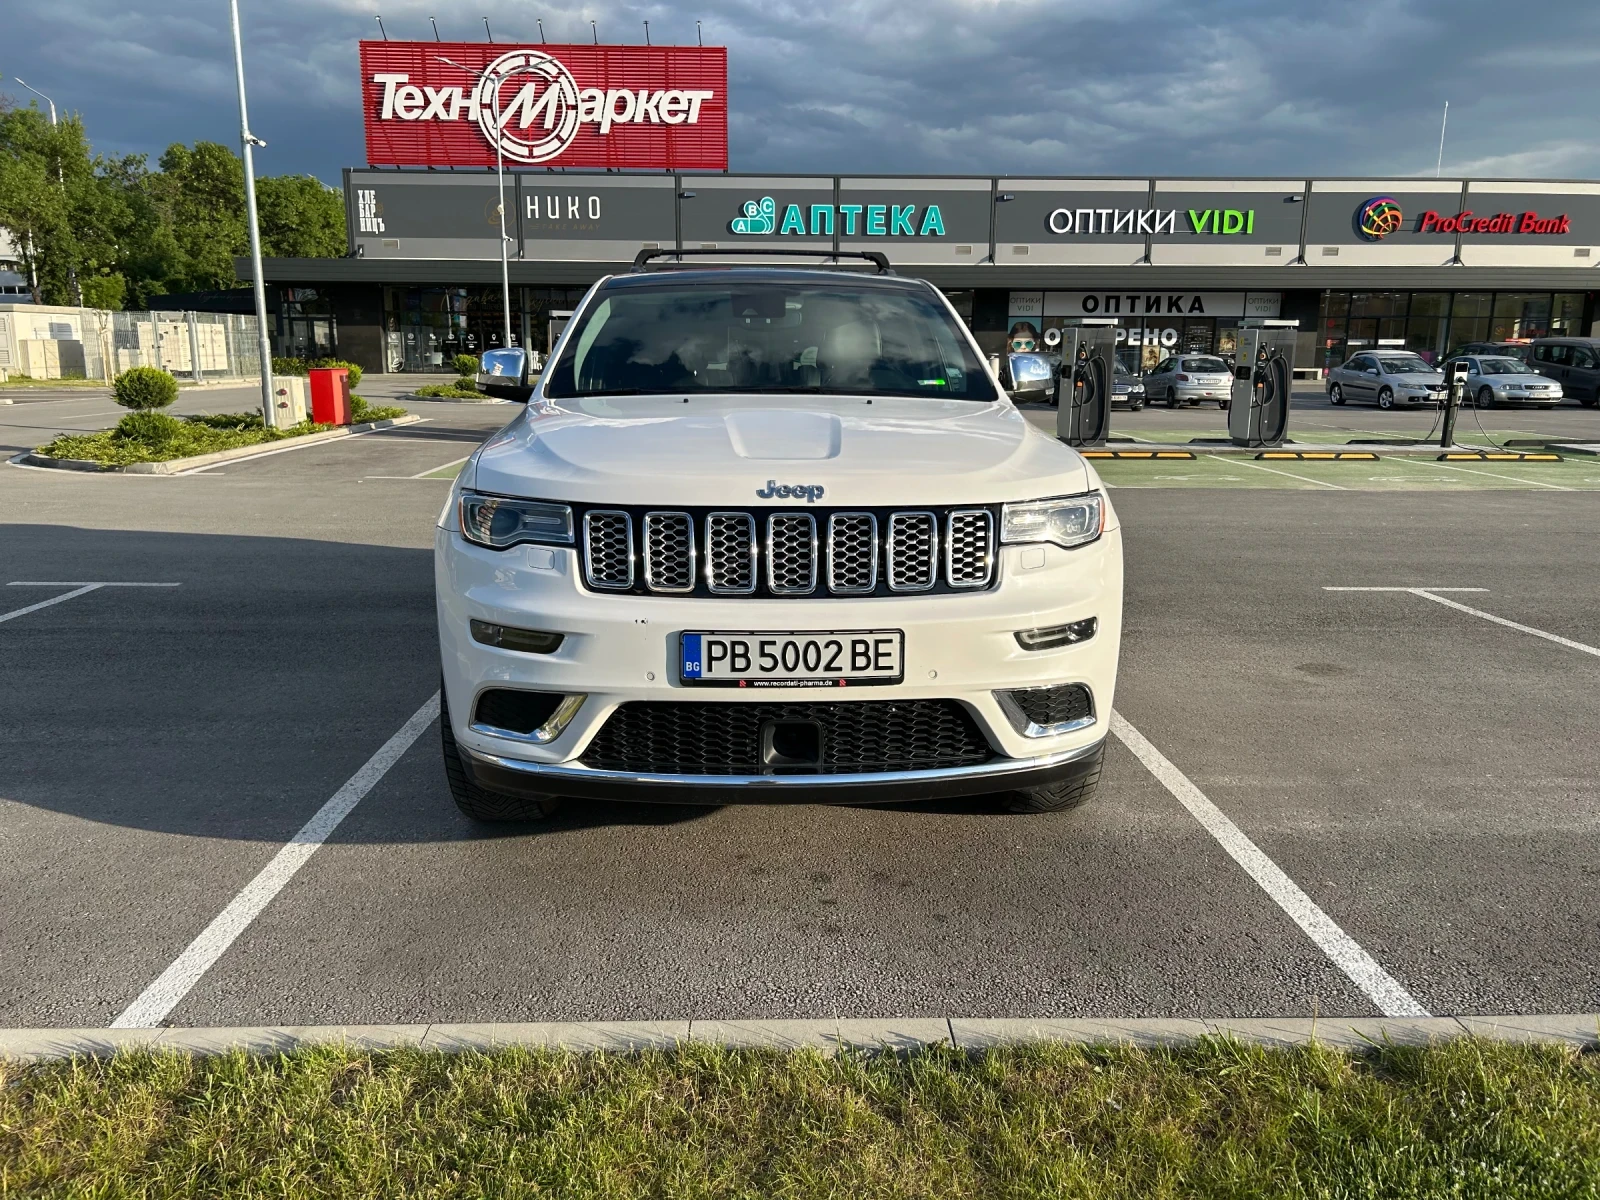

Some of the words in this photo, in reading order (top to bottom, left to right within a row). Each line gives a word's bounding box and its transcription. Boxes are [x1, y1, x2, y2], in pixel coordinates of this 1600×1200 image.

[780, 204, 946, 236] АПТЕКА
[1049, 208, 1176, 234] ОПТИКИ
[1188, 209, 1255, 234] VIDI
[1420, 210, 1516, 234] ProCredit
[1519, 211, 1572, 234] Bank
[1082, 295, 1205, 314] ОПТИКА
[1247, 297, 1280, 305] ОПТИКИ
[1044, 328, 1178, 346] ОРЕНО
[756, 480, 825, 503] Jeep
[685, 661, 700, 672] BG
[707, 640, 751, 673] PB
[758, 640, 843, 673] 5002
[851, 639, 894, 671] BE
[753, 679, 833, 687] www.recordati-pharma.de
